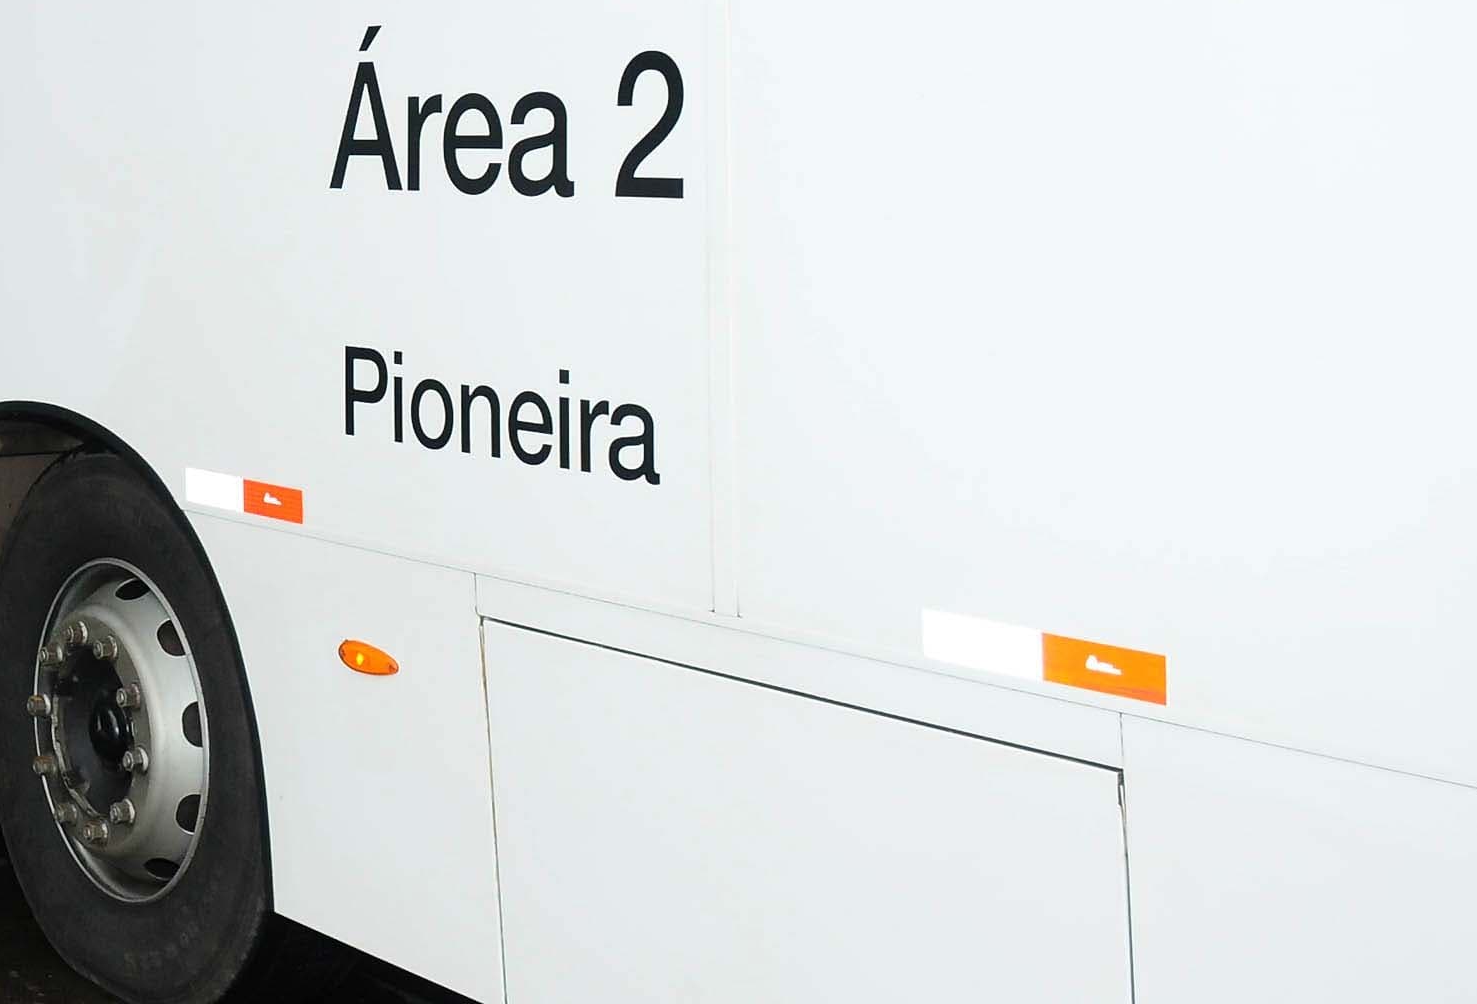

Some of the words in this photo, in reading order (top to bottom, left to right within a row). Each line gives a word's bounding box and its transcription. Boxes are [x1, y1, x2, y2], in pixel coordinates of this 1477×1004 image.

[329, 25, 575, 198] Área
[615, 50, 685, 199] 2
[345, 346, 661, 485] Pioneira
